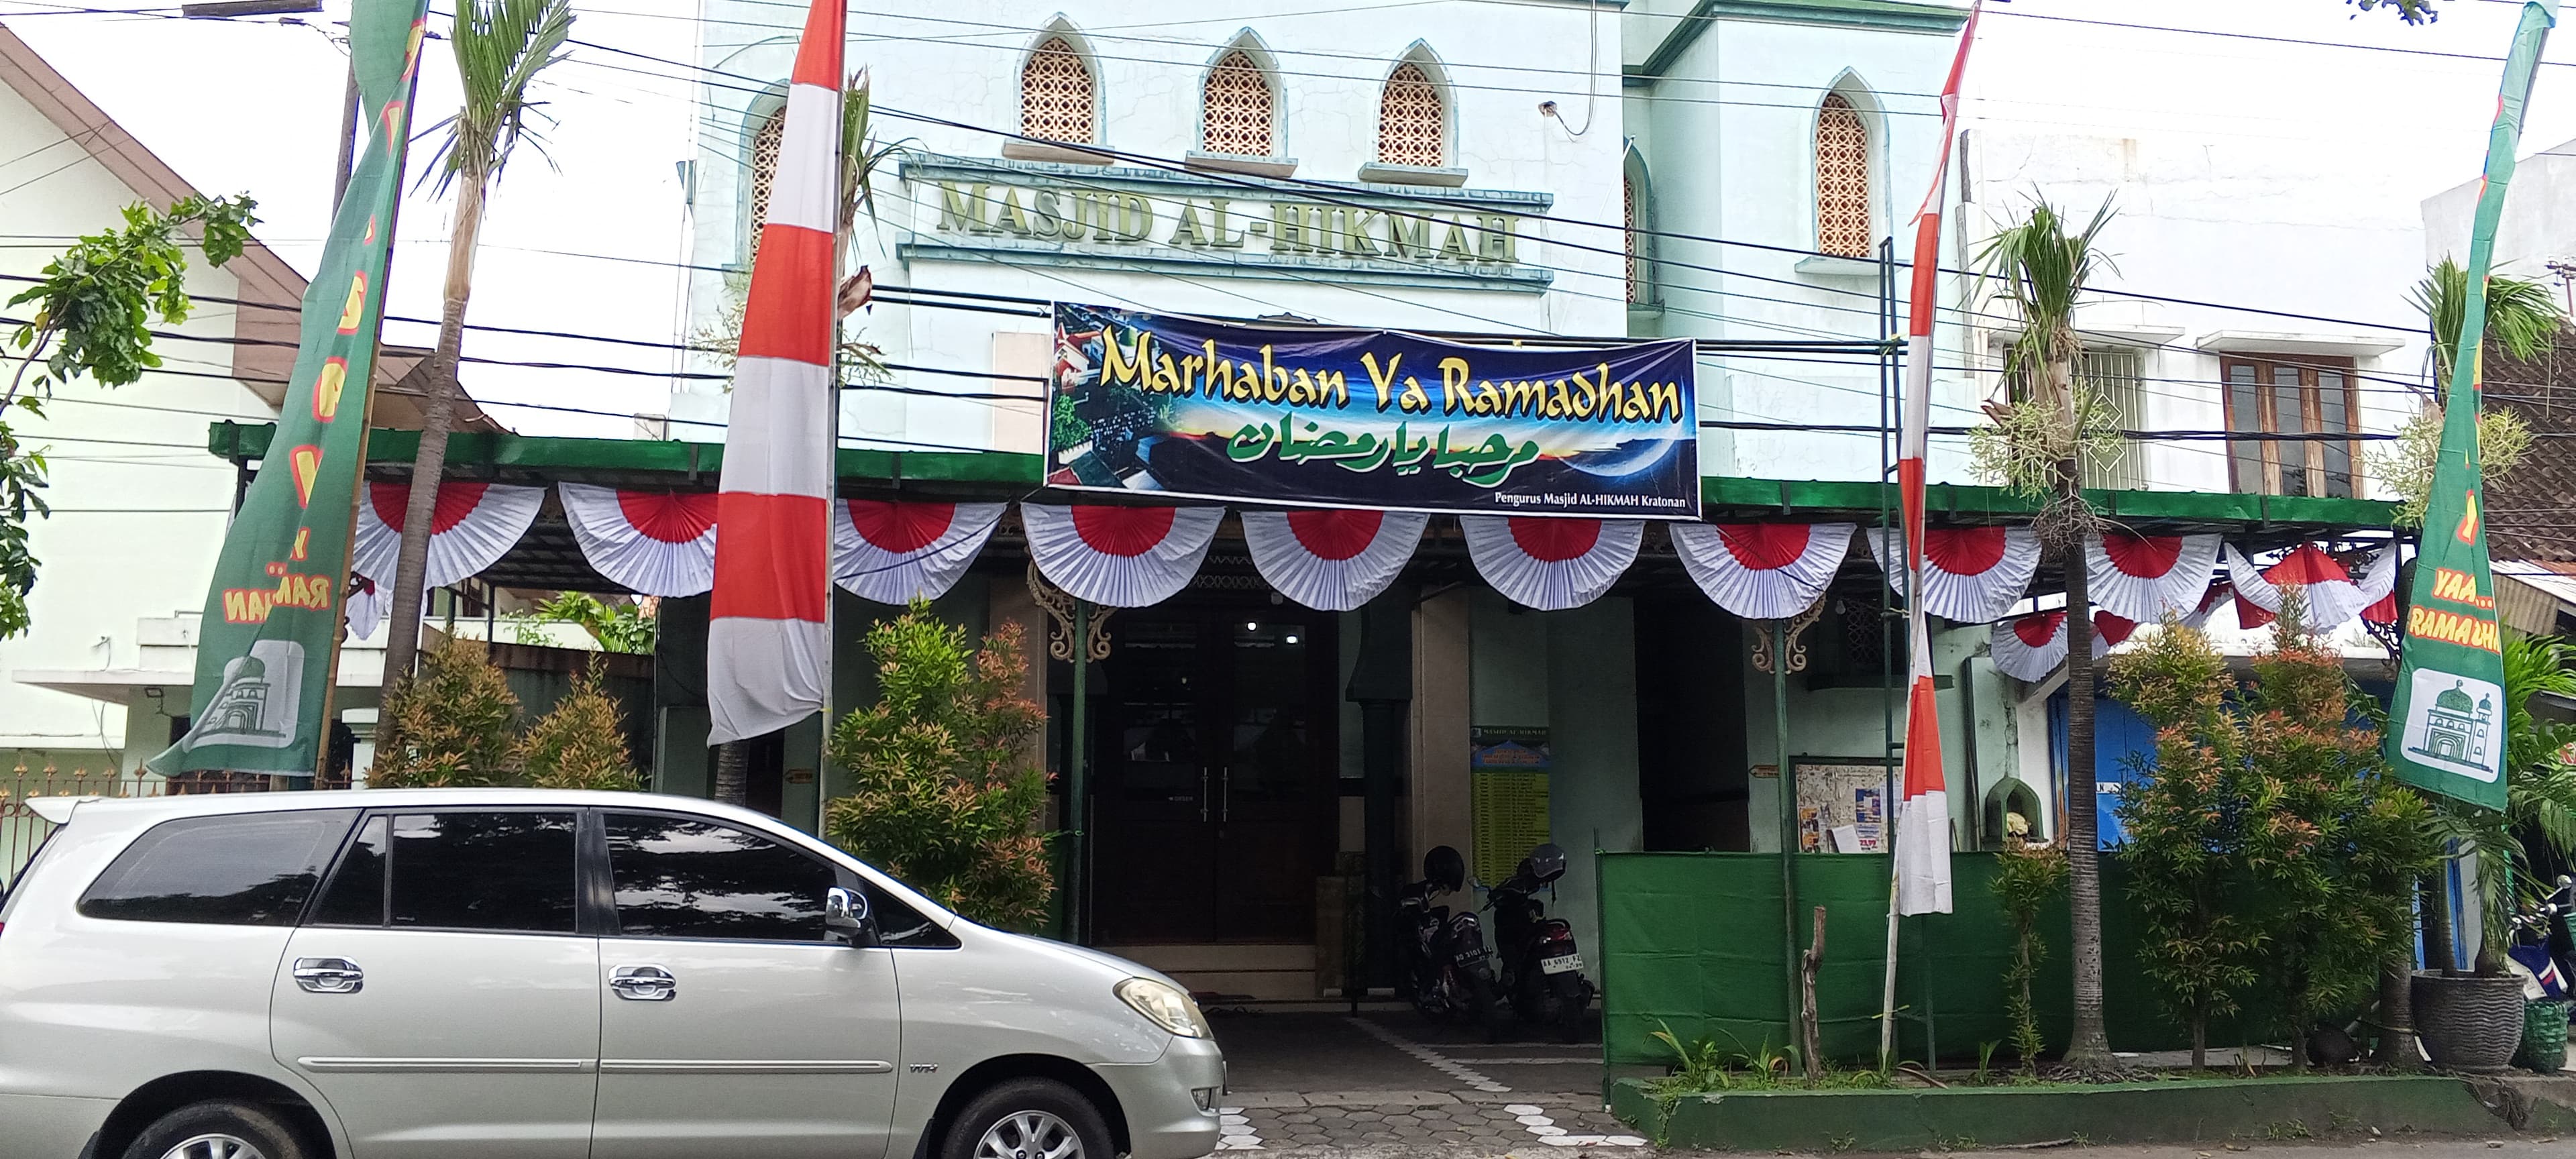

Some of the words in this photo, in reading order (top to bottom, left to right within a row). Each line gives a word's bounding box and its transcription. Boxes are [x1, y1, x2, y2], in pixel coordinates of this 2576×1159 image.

[937, 182, 1153, 243] MASJID
[1169, 197, 1520, 263] AL-HIKMAH
[1102, 326, 1346, 406] Marhaban
[1362, 350, 1430, 413] Ya
[1439, 357, 1683, 423] Ramadhan
[1495, 492, 1542, 507] Pengurus
[1544, 493, 1577, 508] Masjid
[1580, 494, 1639, 506] AL-HIKMAH
[1642, 495, 1686, 508] Kratonan
